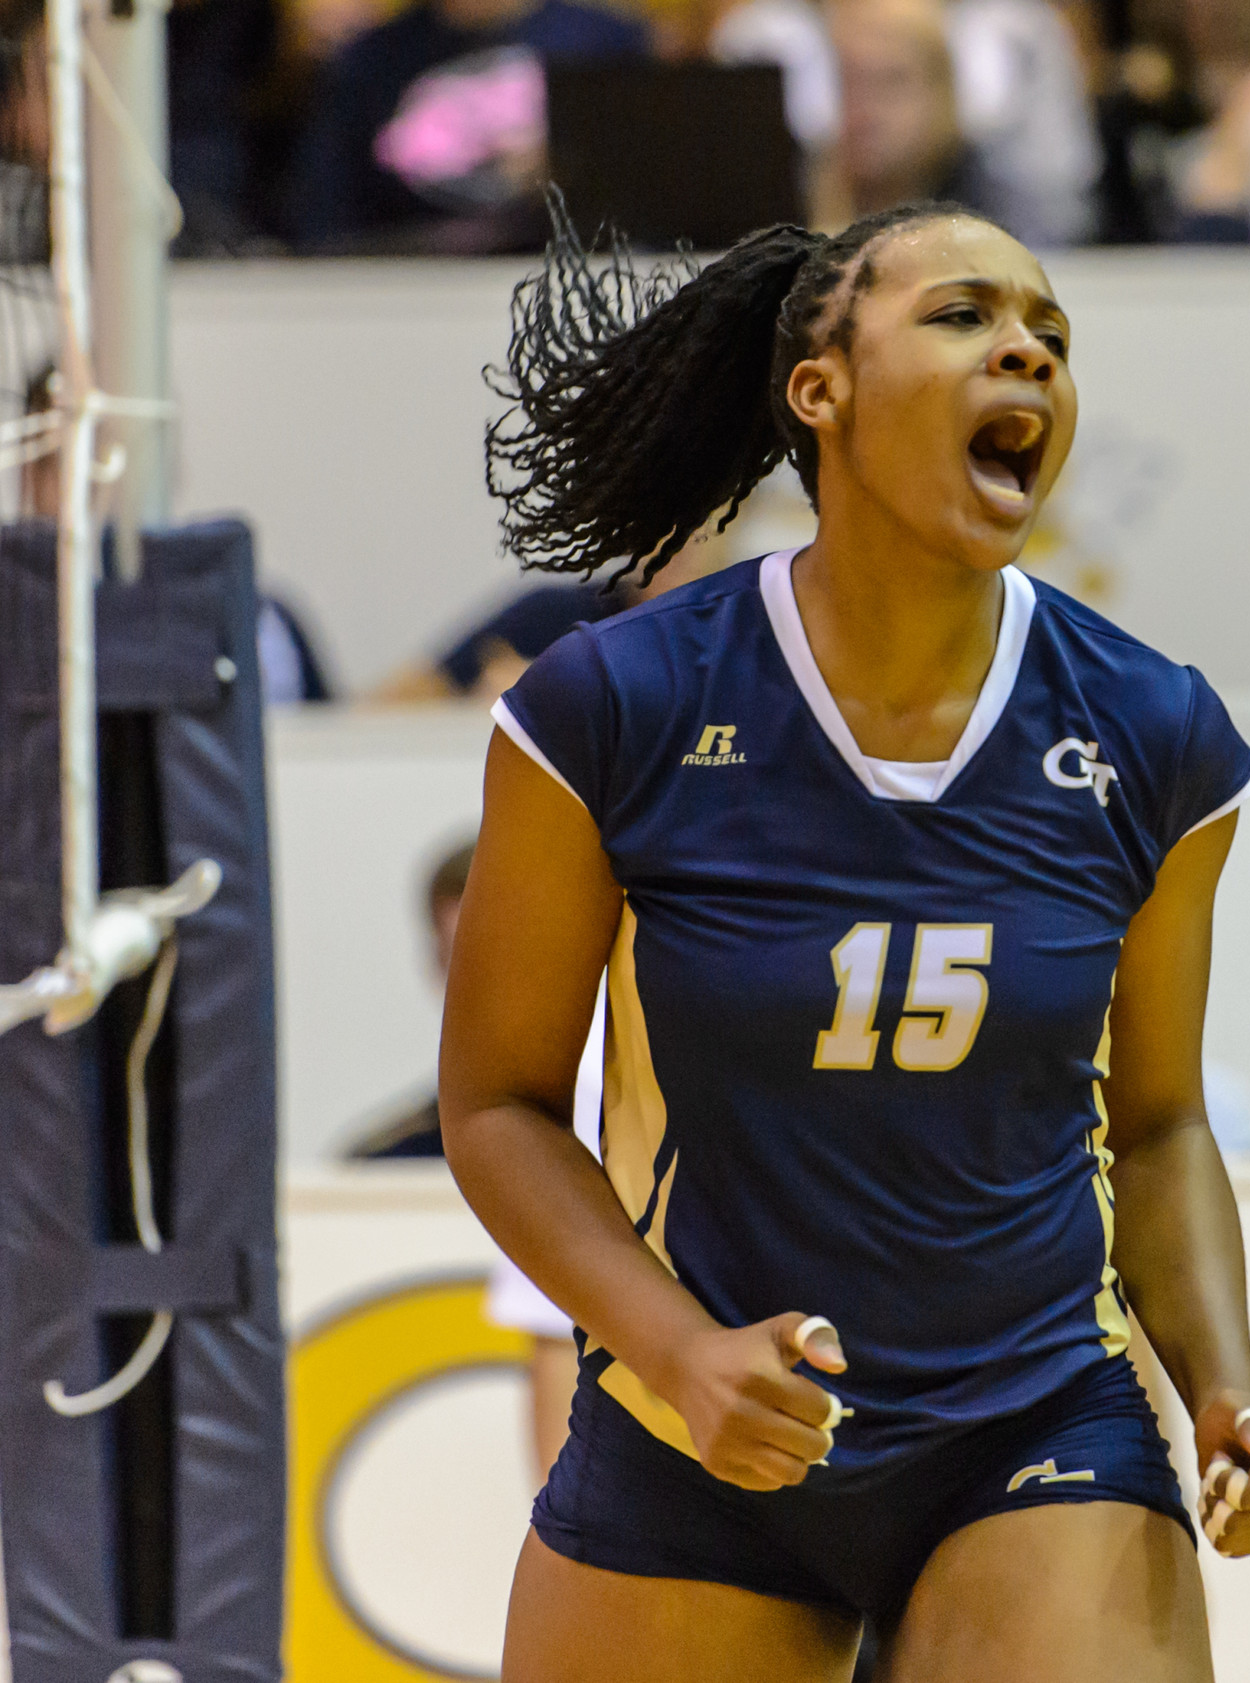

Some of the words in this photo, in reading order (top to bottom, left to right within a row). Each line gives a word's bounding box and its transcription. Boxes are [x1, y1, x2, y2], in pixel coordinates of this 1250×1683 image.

[681, 752, 747, 766] RUSSELL
[695, 724, 736, 754] R
[1042, 737, 1119, 807] GT
[812, 922, 993, 1072] 15
